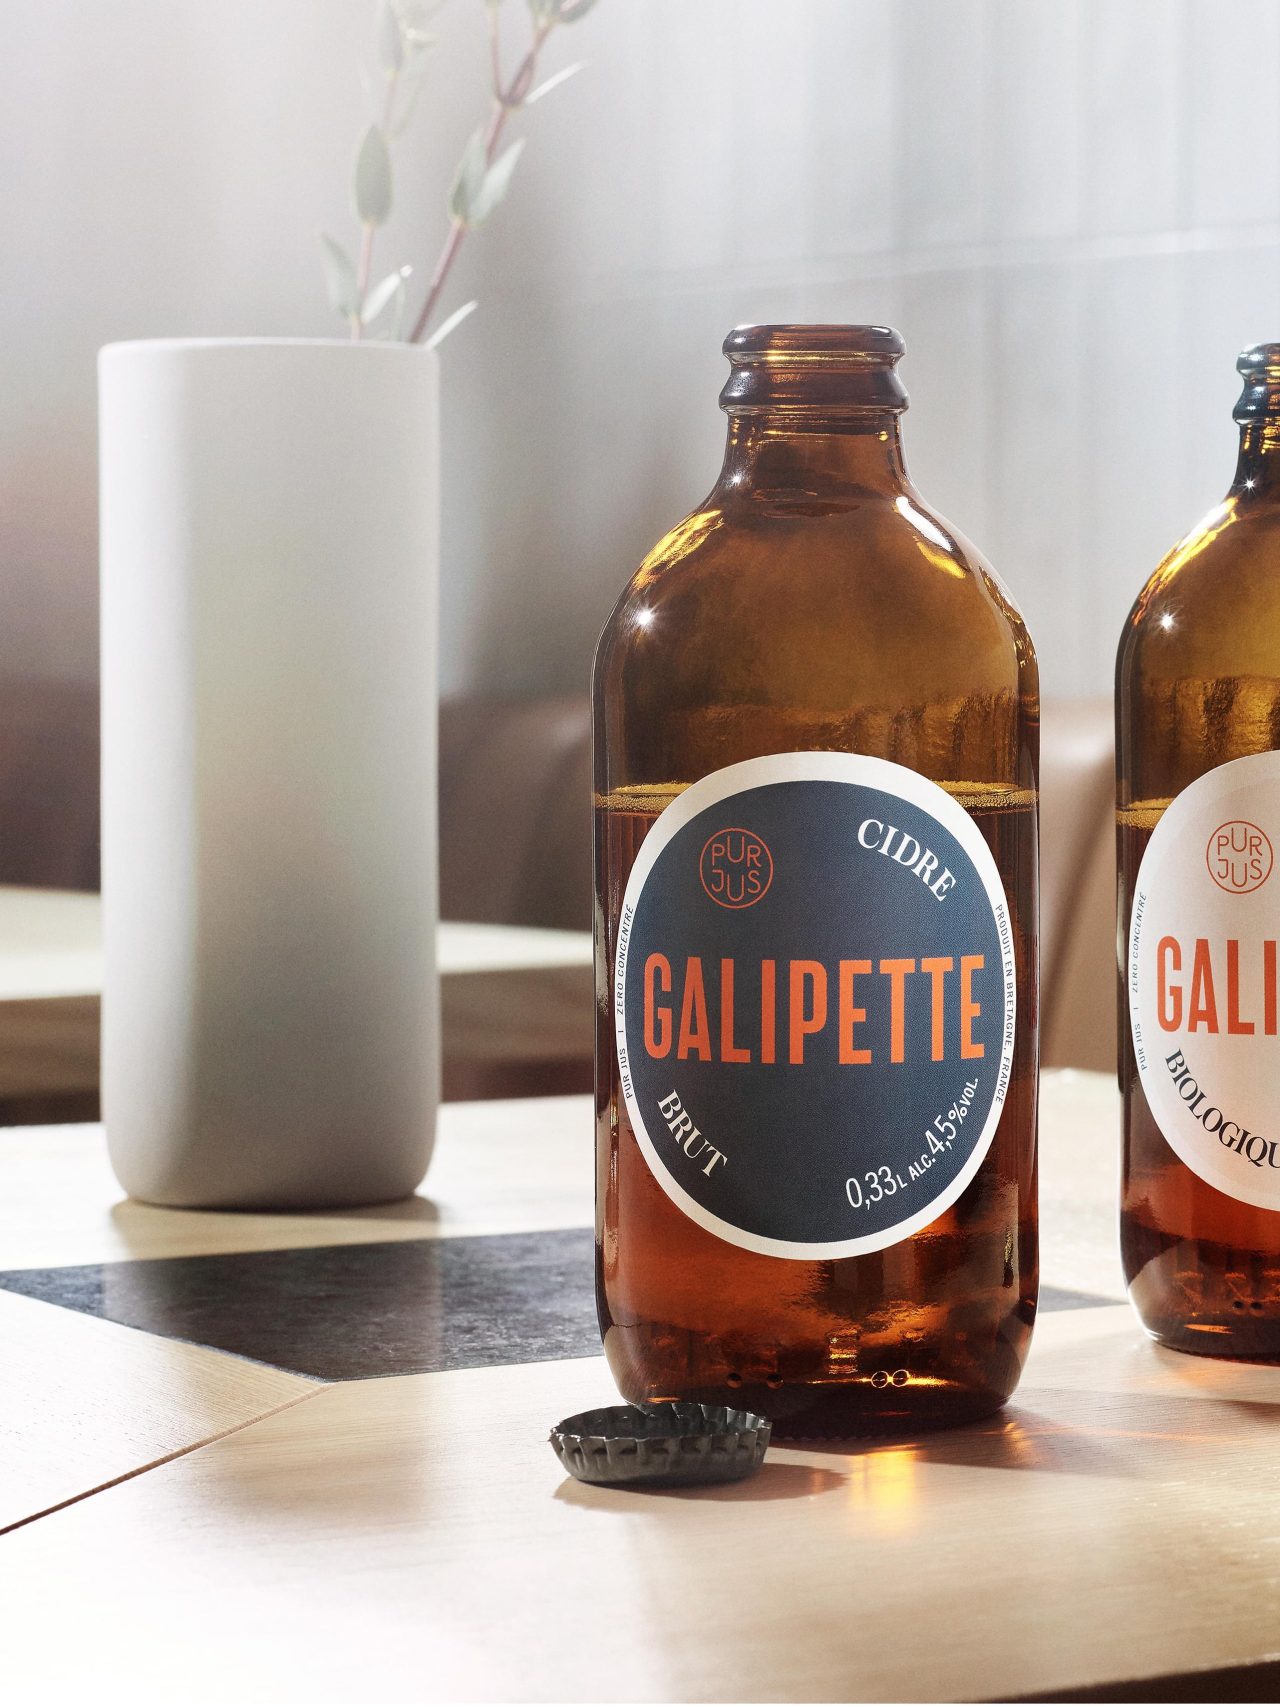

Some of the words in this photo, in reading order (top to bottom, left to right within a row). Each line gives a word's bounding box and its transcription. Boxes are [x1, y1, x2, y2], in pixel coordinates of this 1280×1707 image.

[711, 837, 761, 868] PUR
[1217, 829, 1262, 857] PUR
[857, 819, 957, 902] CIDRE
[1217, 858, 1263, 888] JUS
[711, 869, 761, 901] JUS
[994, 904, 1012, 956] PRODUIT
[1005, 960, 1013, 977] EN
[643, 952, 986, 1065] GALIPETTE
[1134, 1023, 1142, 1044] JUS
[619, 1047, 627, 1069] JUS
[1136, 1047, 1148, 1071] PUR
[622, 1074, 633, 1099] PUR
[995, 1056, 1011, 1105] FRANCE
[658, 1089, 727, 1177] BRUT
